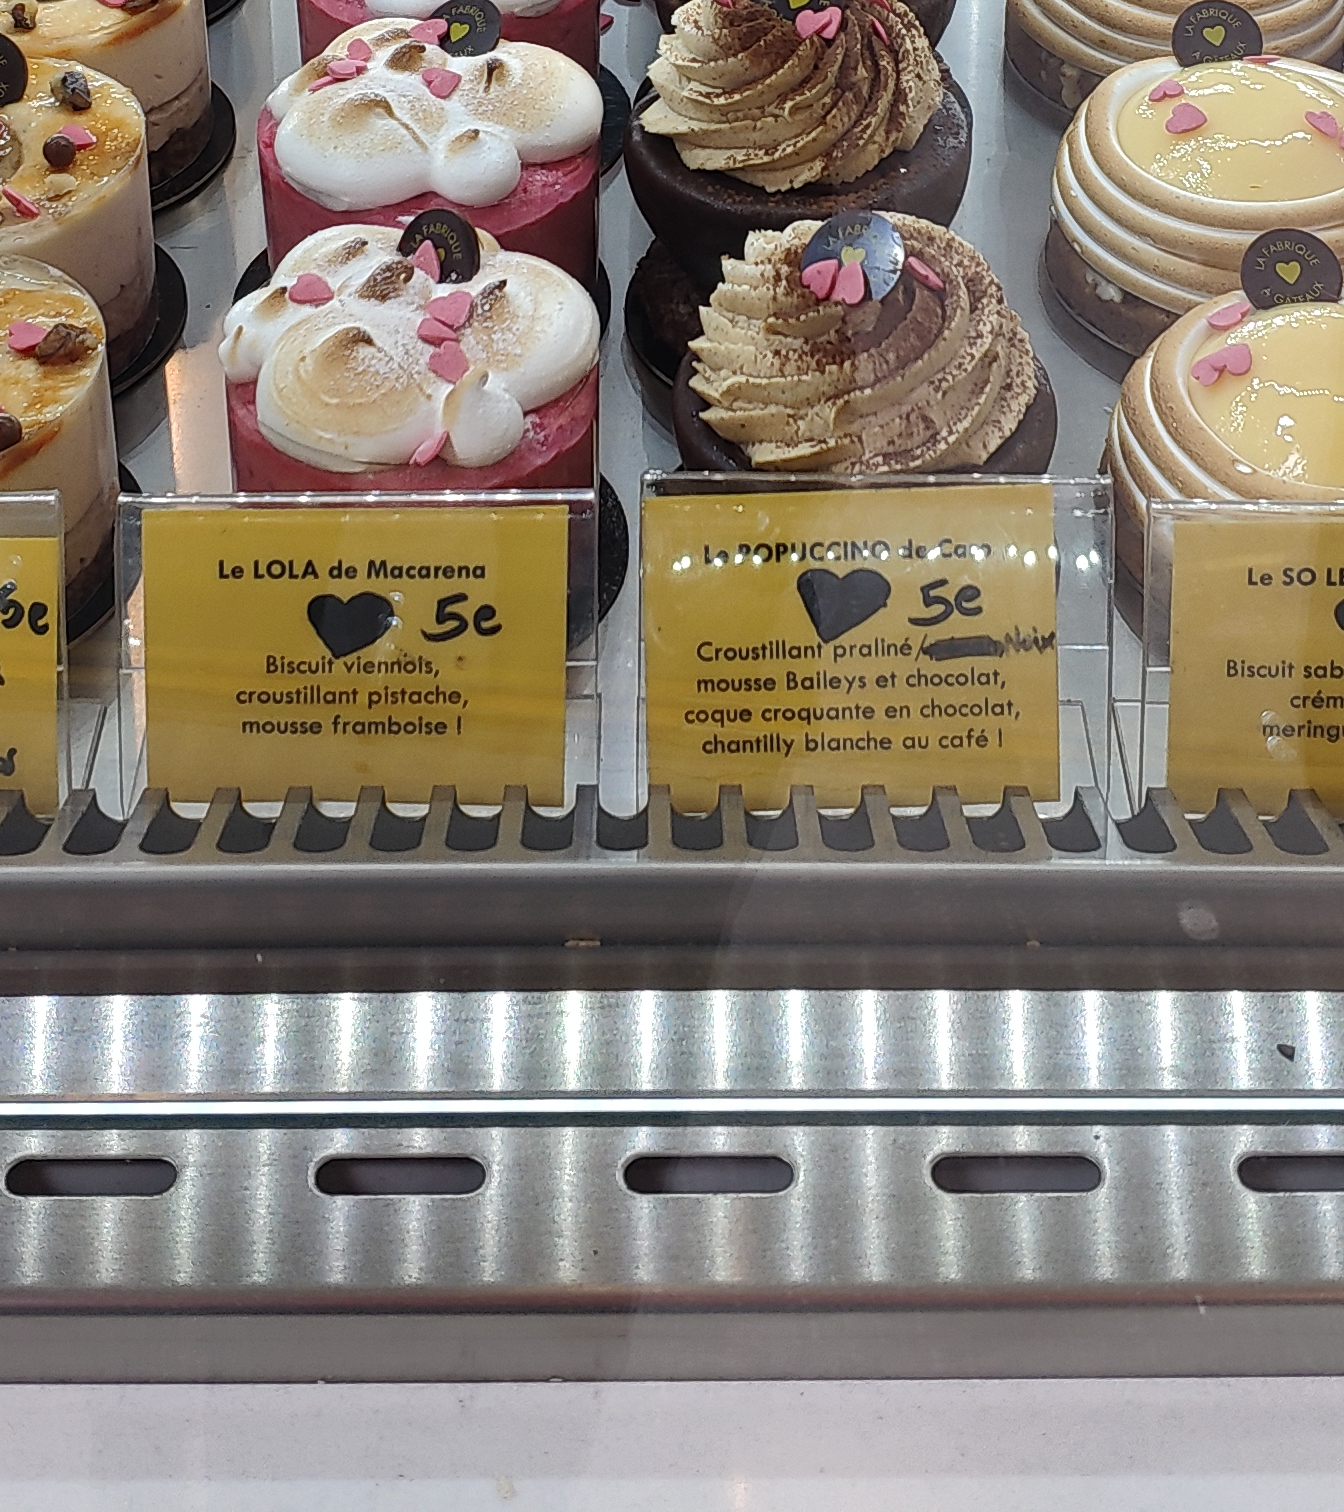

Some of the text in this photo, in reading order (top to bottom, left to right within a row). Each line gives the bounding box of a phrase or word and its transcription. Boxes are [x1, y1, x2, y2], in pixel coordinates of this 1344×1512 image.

[421, 221, 462, 261] FABRIQUE
[1254, 240, 1322, 271] LA FABRIQUE
[218, 558, 487, 580] Le LOLA de Macarena
[1247, 567, 1274, 586] Le
[1281, 567, 1317, 586] SO
[696, 640, 823, 663] Croustillant
[265, 655, 335, 675] Biscuit
[1225, 659, 1295, 679] Biscuit
[696, 667, 1007, 695] mousse Baileys et chocolat,
[235, 685, 469, 710] croustillant pistache,
[684, 698, 1021, 726] coque croquante en chocolat,
[241, 717, 323, 735] mousse
[331, 714, 448, 736] framboise
[701, 732, 794, 757] chantilly
[804, 732, 893, 752] blanche
[901, 735, 929, 750] au
[938, 727, 989, 750] café
